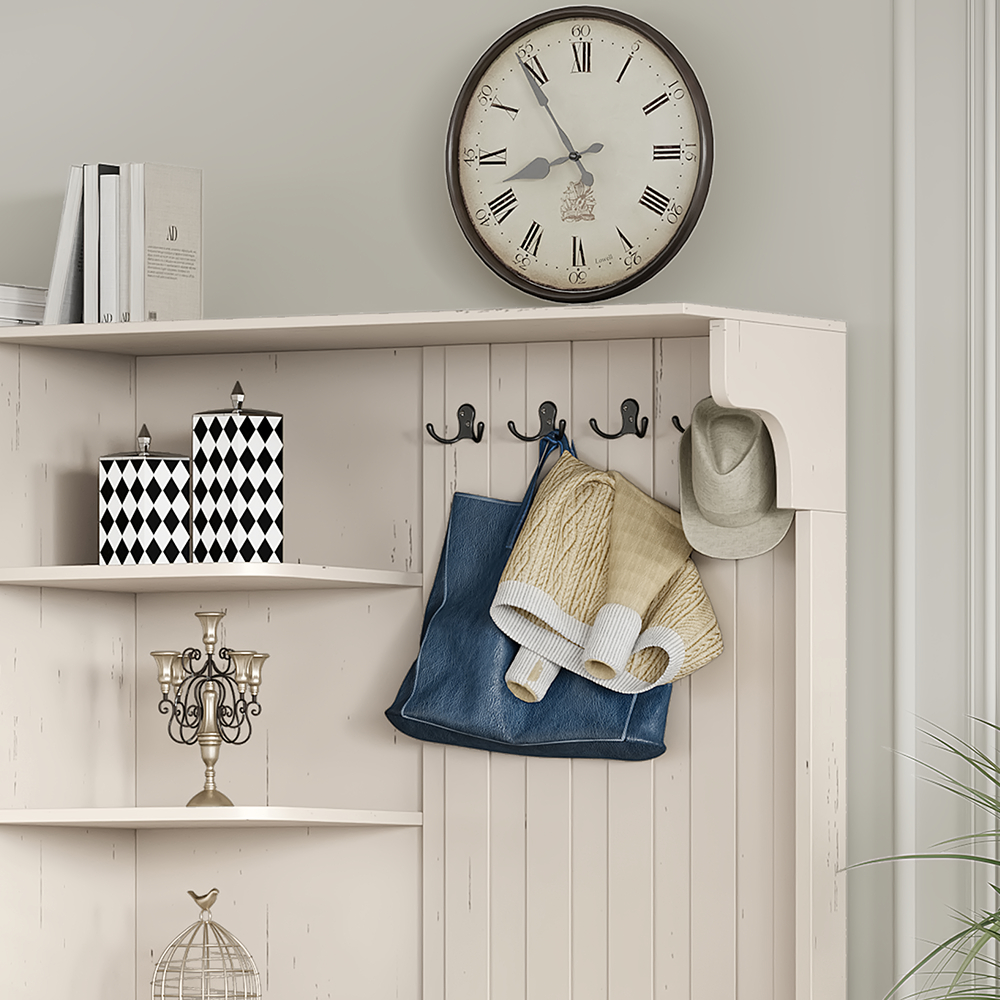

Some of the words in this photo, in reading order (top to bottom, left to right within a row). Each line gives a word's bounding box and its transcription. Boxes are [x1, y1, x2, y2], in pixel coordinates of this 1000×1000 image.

[571, 24, 591, 37] 60
[517, 40, 535, 58] 55
[631, 39, 643, 52] 5
[570, 41, 592, 73] XII
[478, 84, 493, 107] 50
[667, 80, 685, 101] 10
[490, 95, 520, 121] X
[463, 147, 475, 167] 45
[685, 143, 697, 163] 15
[475, 208, 491, 228] 40
[666, 204, 683, 225] 20
[166, 225, 178, 241] AD
[513, 252, 531, 271] 35
[623, 252, 643, 271] 25
[568, 271, 588, 285] 30
[101, 313, 113, 323] AD
